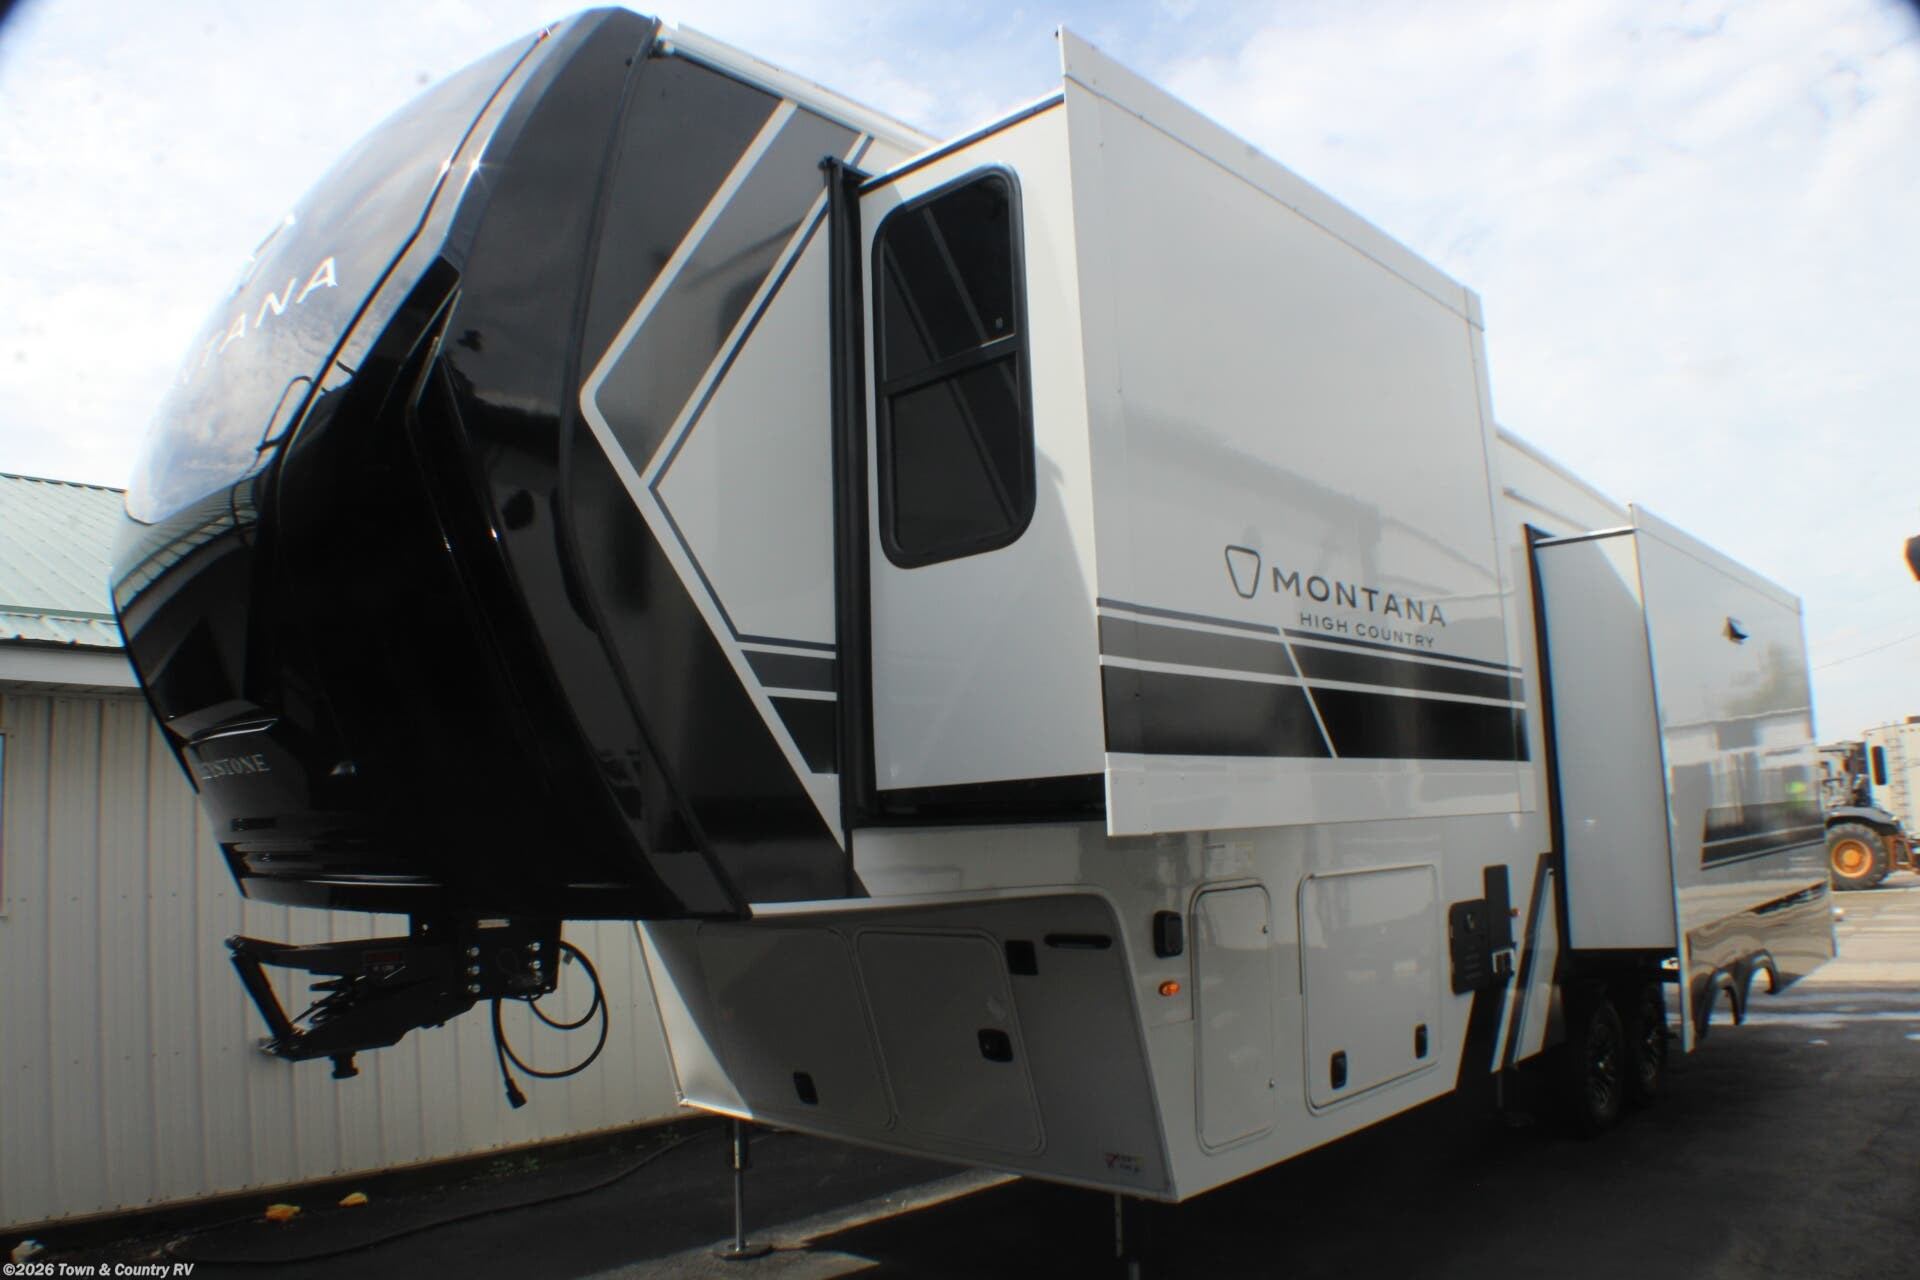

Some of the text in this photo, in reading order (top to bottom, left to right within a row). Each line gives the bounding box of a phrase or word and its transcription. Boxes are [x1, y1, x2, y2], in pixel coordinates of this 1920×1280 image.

[1272, 566, 1447, 628] MONTANA
[1300, 611, 1434, 648] HIGH COUNTRY
